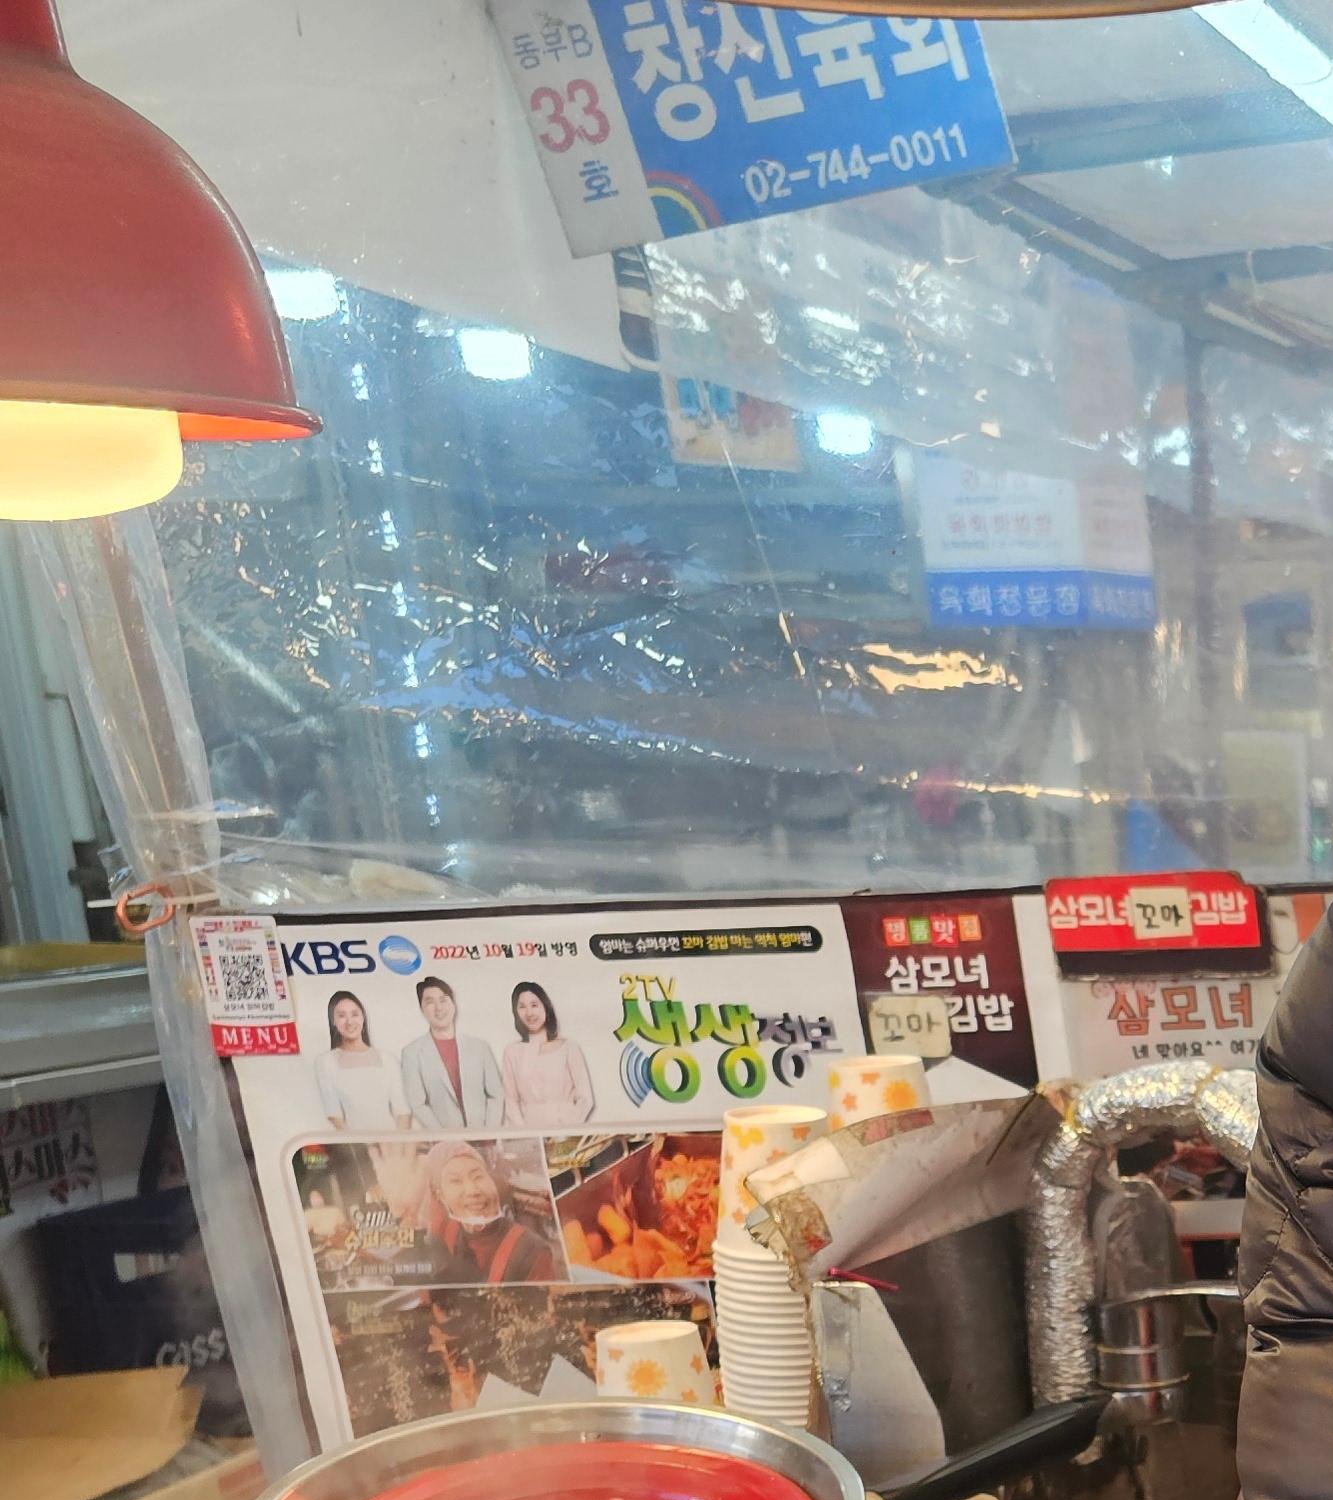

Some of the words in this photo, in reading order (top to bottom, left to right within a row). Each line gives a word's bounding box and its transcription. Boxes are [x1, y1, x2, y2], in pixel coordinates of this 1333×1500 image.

[623, 0, 970, 141] 창신육회
[530, 78, 610, 153] 33
[743, 123, 968, 203] 02-744-0011
[1049, 890, 1133, 929] 삼모녀
[1136, 902, 1184, 929] 꼬마
[1190, 891, 1248, 925] 김밥
[280, 940, 376, 976] KBS
[433, 943, 481, 960] 2022년
[484, 943, 514, 960] 10월
[518, 941, 547, 958] 19일
[619, 973, 676, 1000] 2TV
[884, 954, 988, 993] 삼모녀
[948, 994, 1014, 1033] 김밥
[1108, 983, 1252, 1036] 삼모녀
[222, 1027, 288, 1046] MENU
